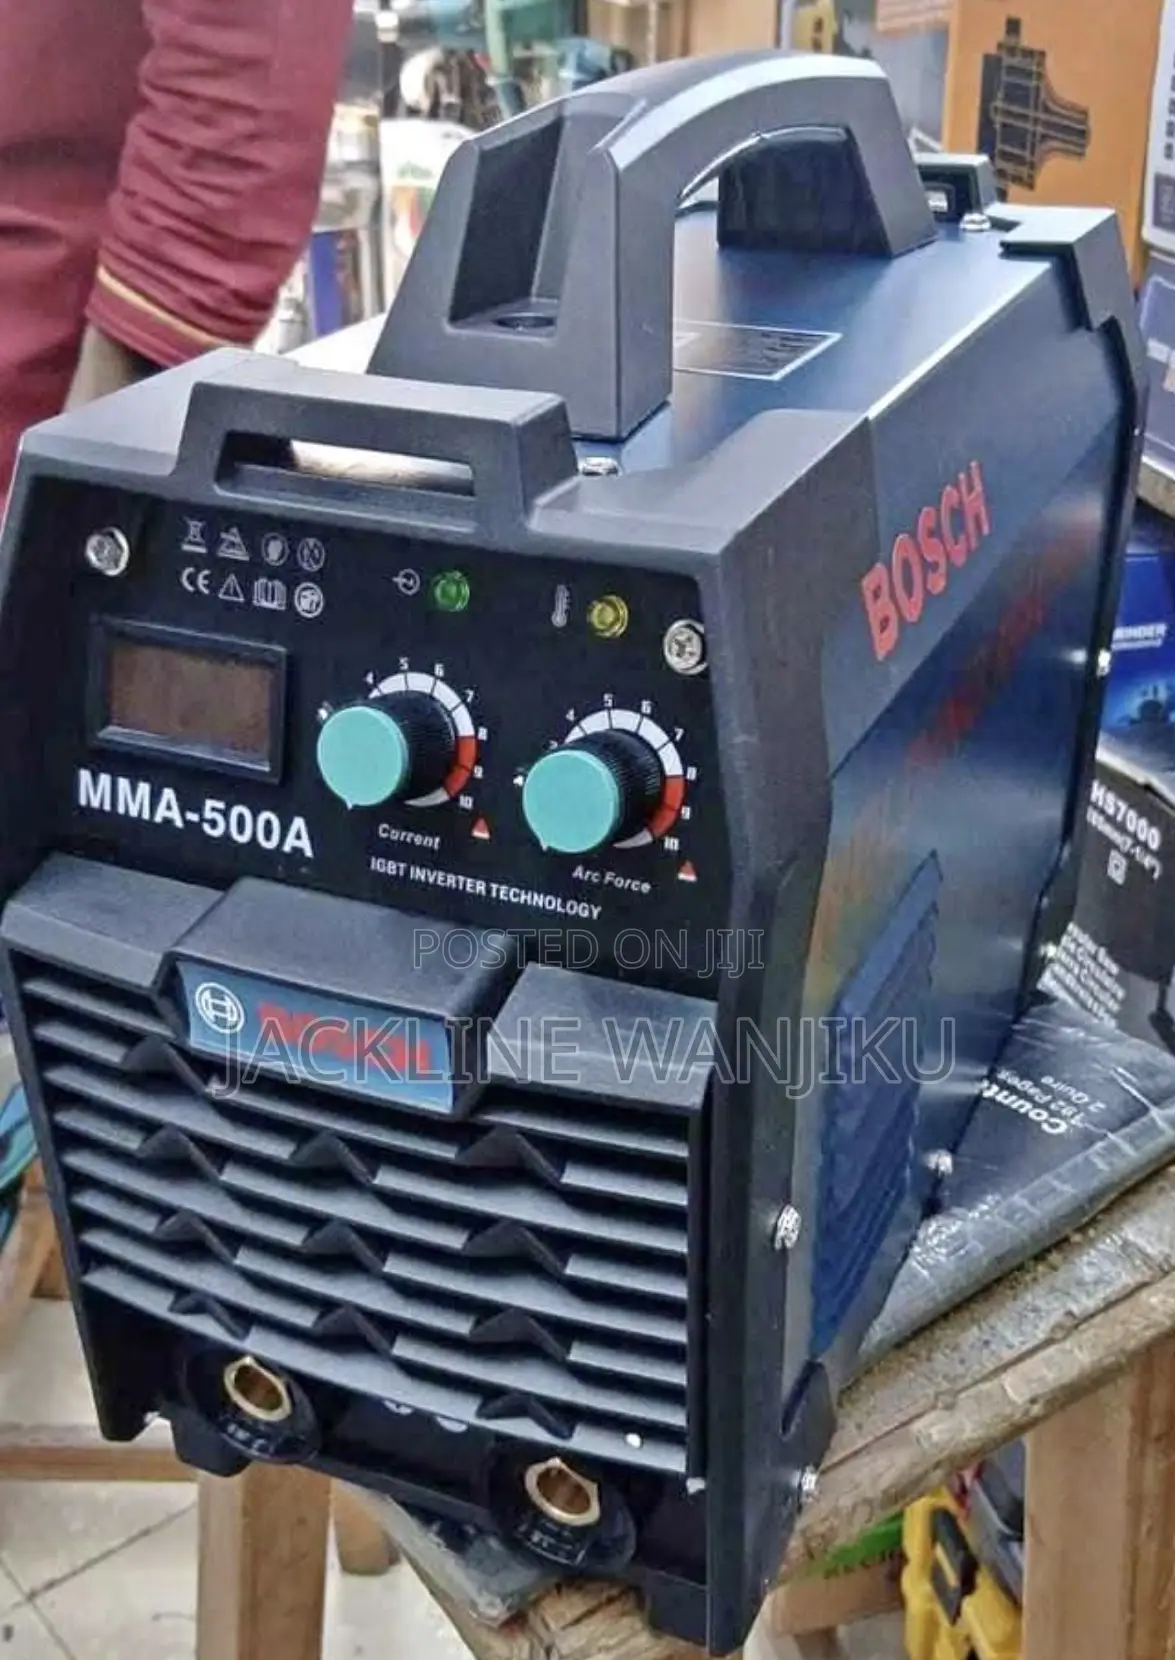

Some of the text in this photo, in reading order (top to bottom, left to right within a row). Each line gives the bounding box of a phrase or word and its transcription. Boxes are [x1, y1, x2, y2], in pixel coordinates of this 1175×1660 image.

[180, 567, 211, 595] CE
[861, 460, 990, 662] BOSCH
[365, 656, 488, 810] 4 5 6 7 8 9 10
[565, 693, 697, 853] 4 5 6 7 8 9 10
[78, 768, 314, 858] MMA-500A
[378, 823, 441, 850] Current
[370, 856, 602, 921] IGBT INVERTER TECHNOLOGY
[571, 864, 651, 895] Arc Force
